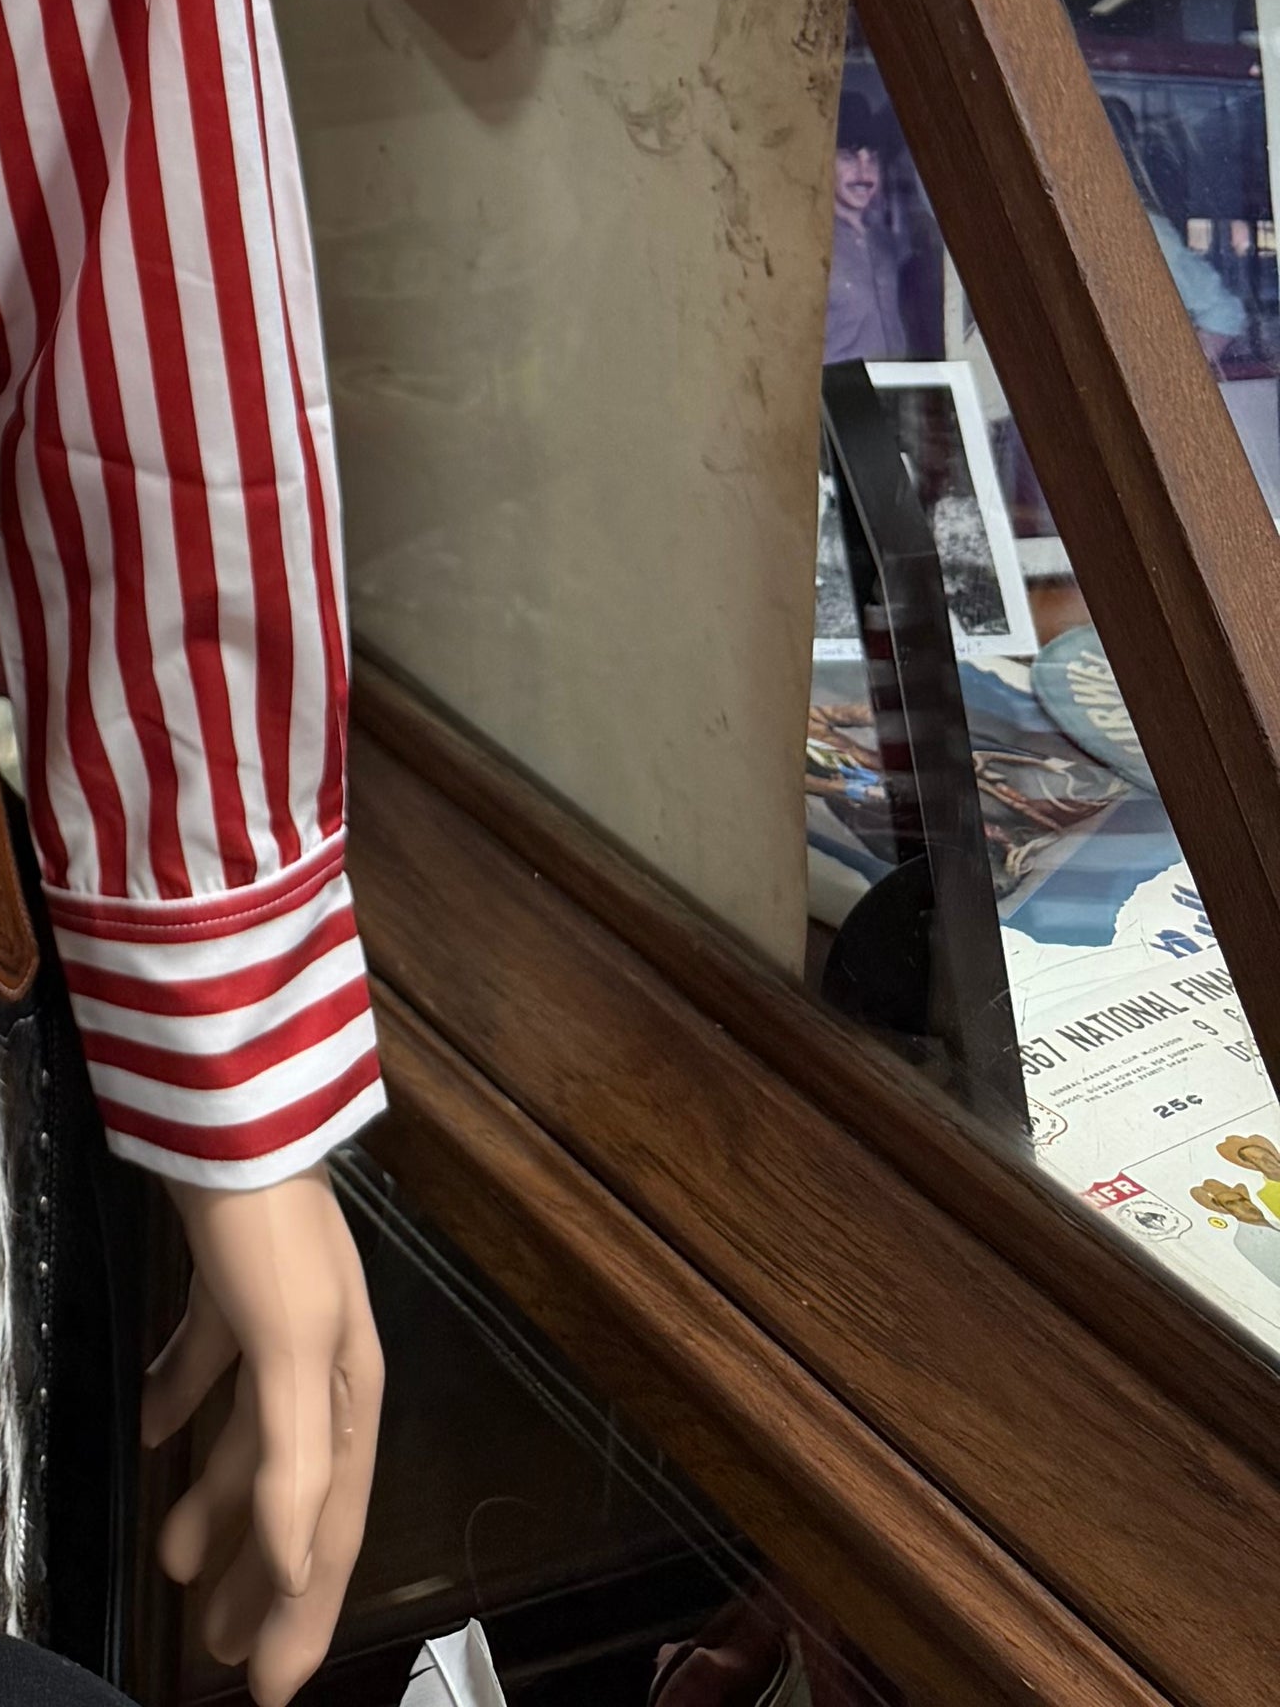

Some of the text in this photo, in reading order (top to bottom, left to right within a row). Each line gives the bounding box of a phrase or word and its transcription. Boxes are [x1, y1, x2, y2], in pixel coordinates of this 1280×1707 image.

[1055, 990, 1190, 1052] NATIONAL
[1153, 1094, 1203, 1119] 25¢
[1084, 1179, 1141, 1211] NFR
